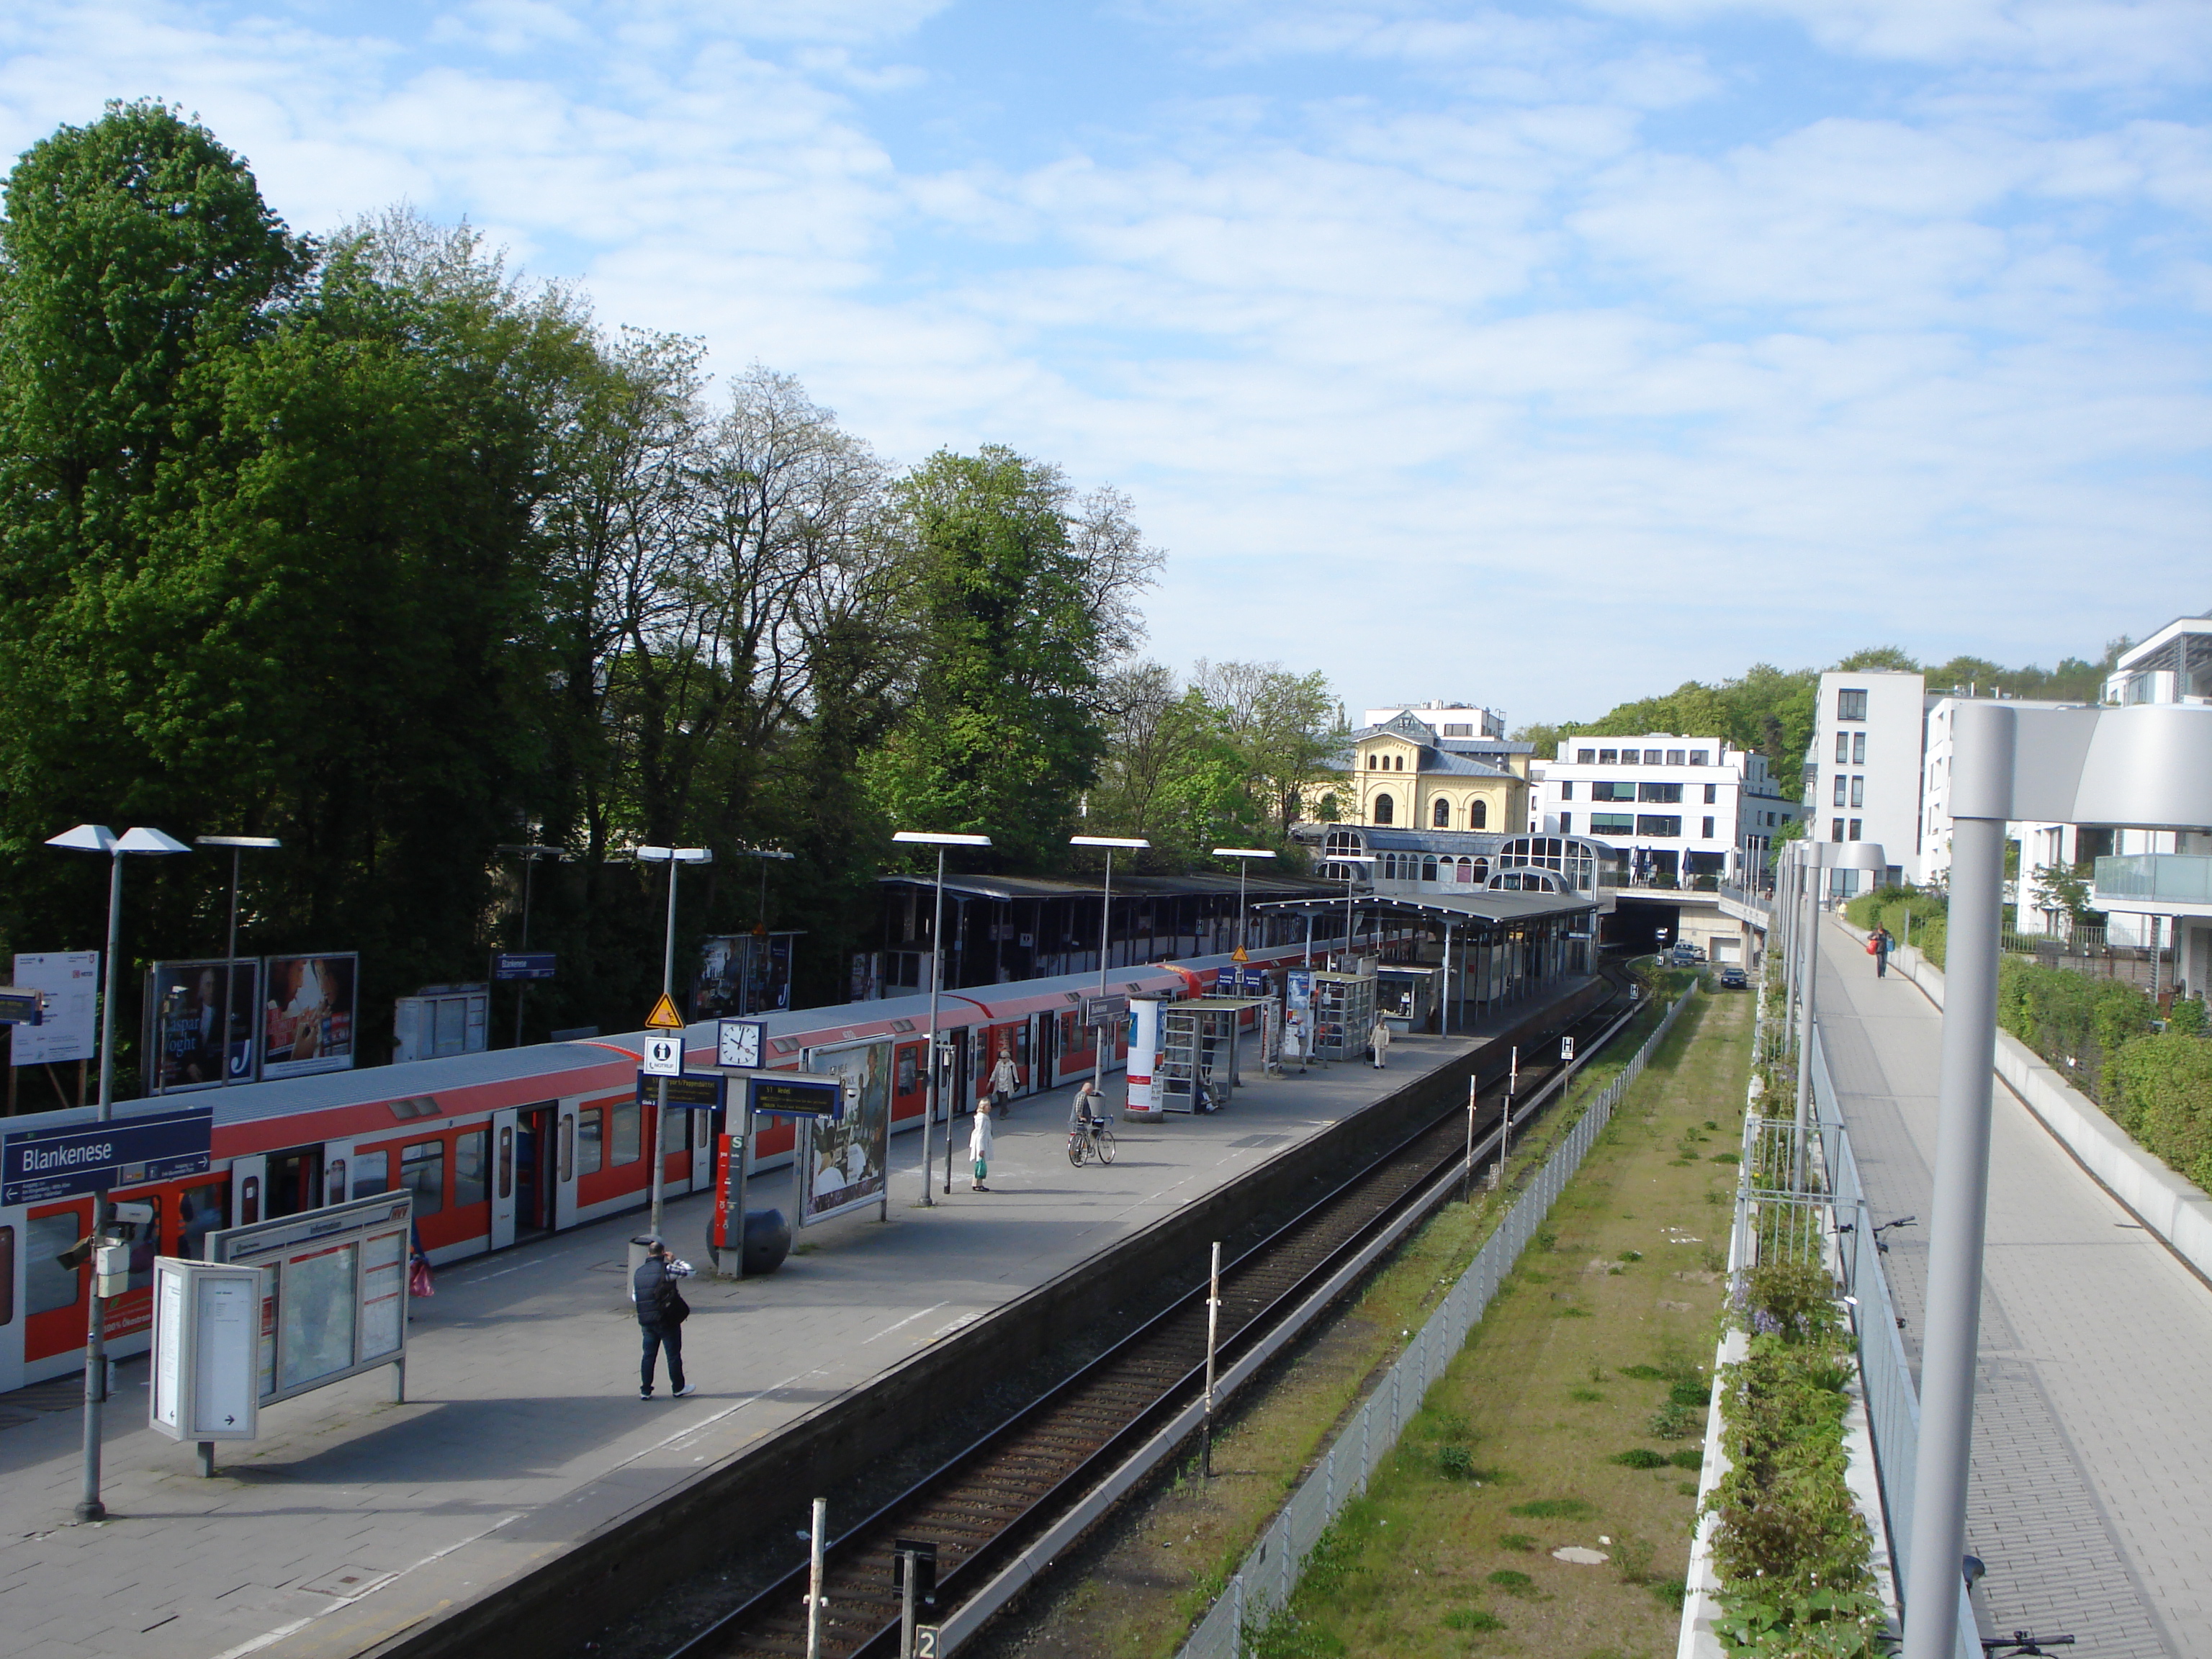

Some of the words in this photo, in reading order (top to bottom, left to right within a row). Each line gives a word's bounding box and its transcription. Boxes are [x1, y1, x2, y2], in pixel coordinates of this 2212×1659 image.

[1197, 920, 1202, 929] H
[1632, 985, 1637, 994] H
[1564, 1038, 1572, 1051] H
[732, 1136, 742, 1148] S
[23, 1143, 112, 1172] Blankenese
[310, 1221, 341, 1234] Information
[920, 1633, 935, 1658] 2
